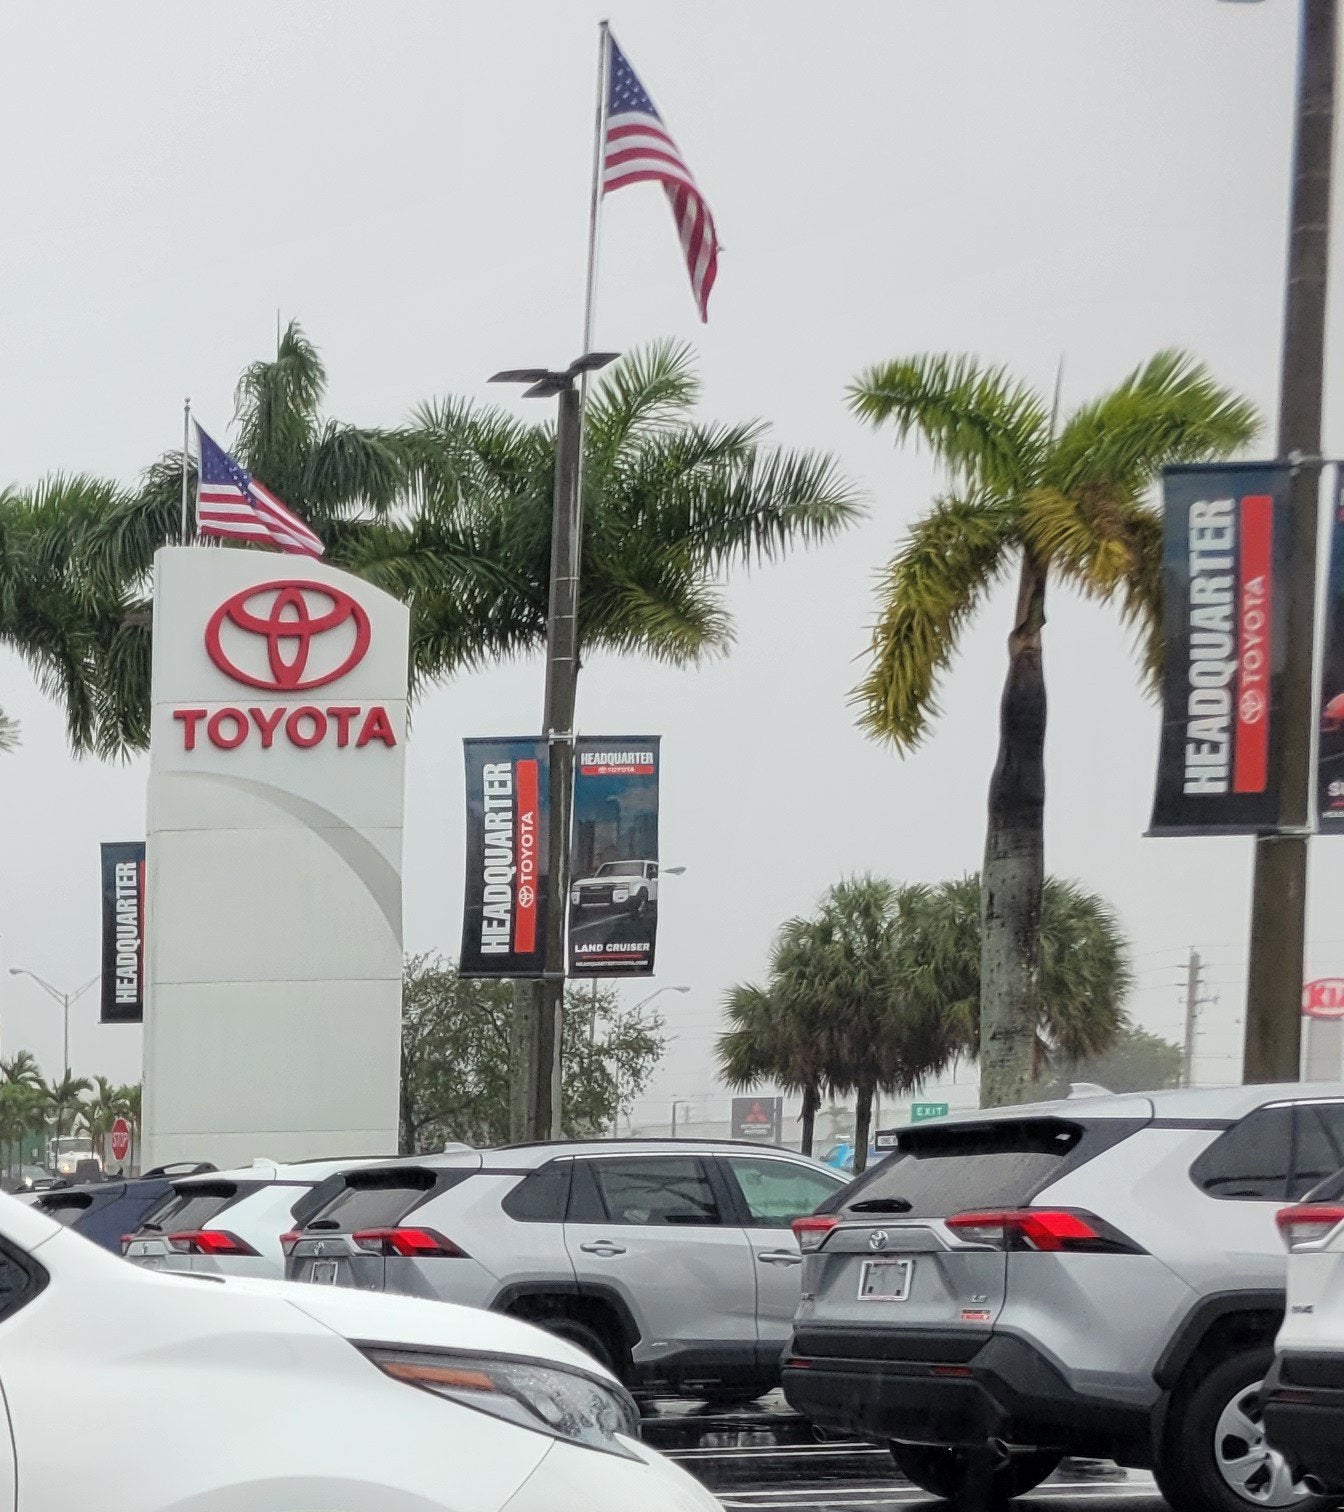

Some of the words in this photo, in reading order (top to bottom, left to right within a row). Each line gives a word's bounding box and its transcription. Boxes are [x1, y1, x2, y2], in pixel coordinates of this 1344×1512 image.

[1183, 498, 1238, 794] HEADQUARTER
[1243, 574, 1266, 688] TOYOTA
[173, 706, 397, 750] TOYOTA
[581, 752, 654, 766] HEADQUARTER
[480, 762, 516, 953] HEADQUARTER
[520, 812, 534, 883] TOYOTA
[115, 861, 141, 1004] HEADQUARTER
[575, 944, 603, 953] LAND
[606, 943, 650, 952] CRUISER
[917, 1107, 943, 1116] EXIT
